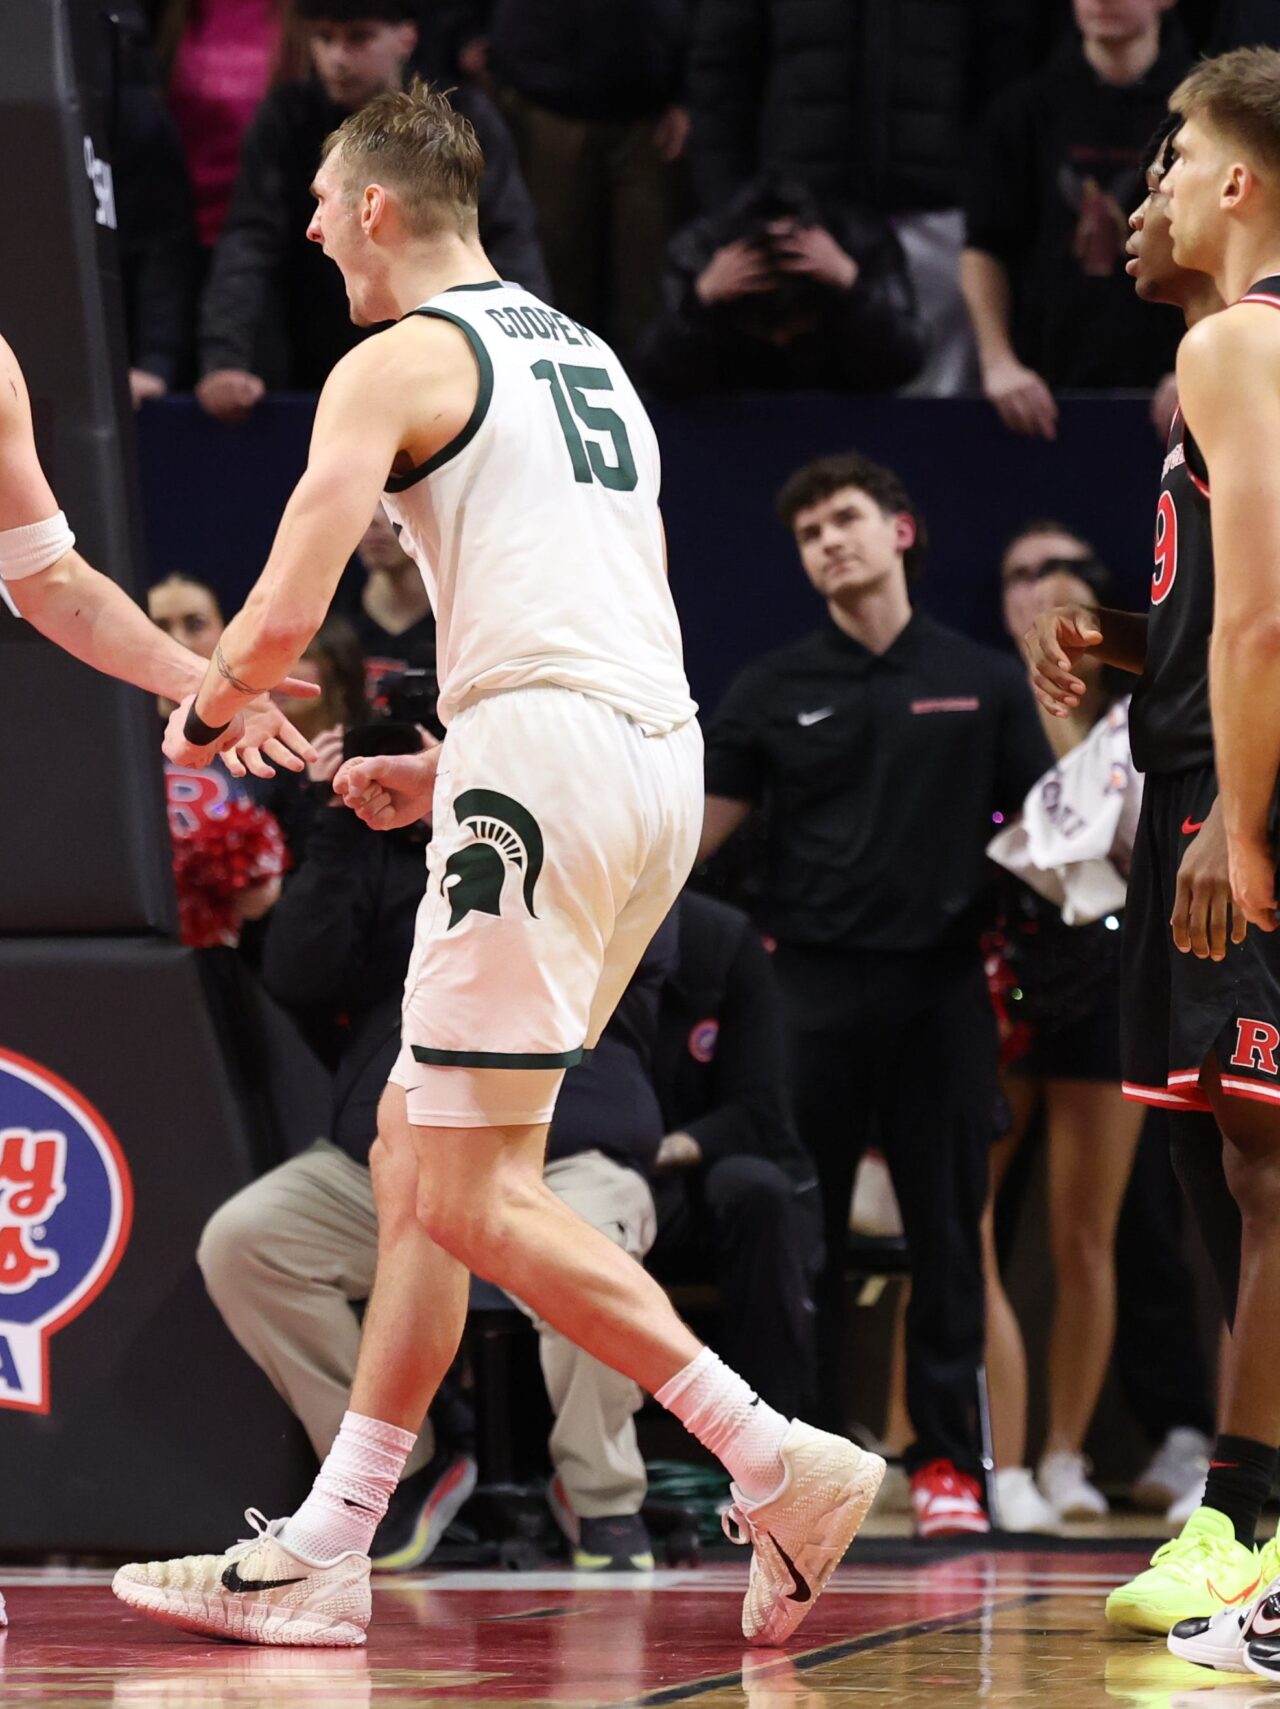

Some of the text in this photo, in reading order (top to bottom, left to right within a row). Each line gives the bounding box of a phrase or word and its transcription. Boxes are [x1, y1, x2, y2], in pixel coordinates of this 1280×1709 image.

[485, 306, 600, 350] COOPER
[530, 359, 639, 492] 15
[1151, 490, 1178, 605] 9
[1230, 1017, 1280, 1075] R
